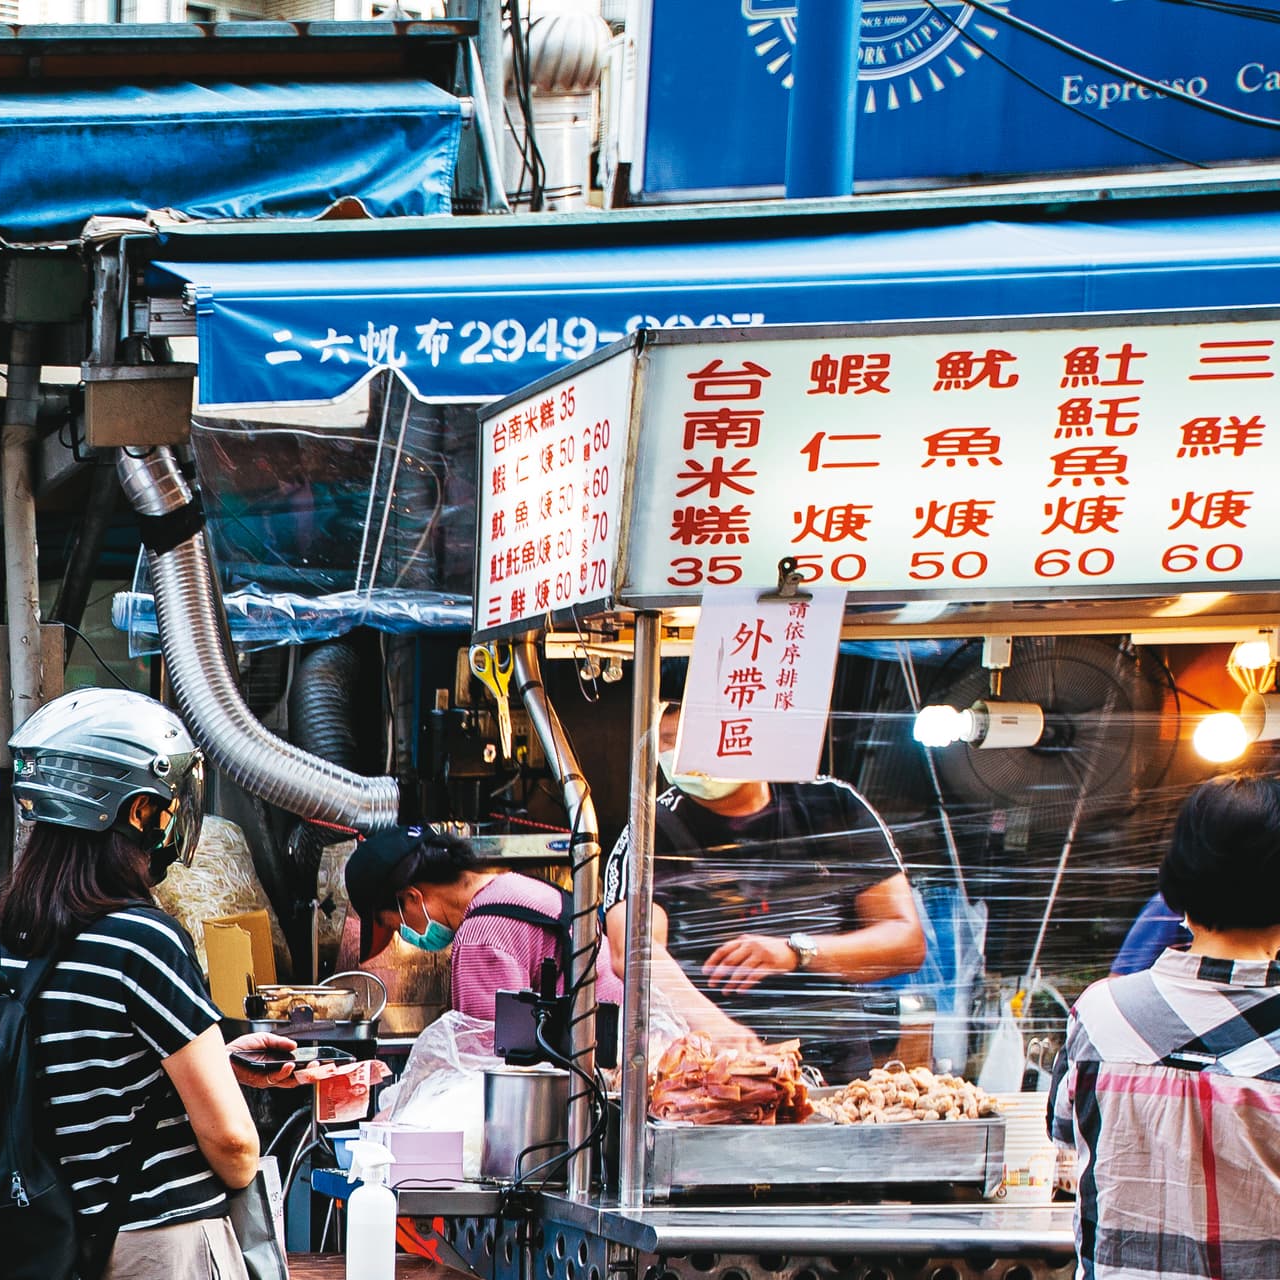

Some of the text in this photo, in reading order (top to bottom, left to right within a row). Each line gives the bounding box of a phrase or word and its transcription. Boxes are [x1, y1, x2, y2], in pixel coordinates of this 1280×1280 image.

[492, 385, 576, 455] 台南米糕 35
[592, 419, 611, 453] 60
[558, 434, 575, 467] 50
[667, 358, 772, 545] 台南米糕
[557, 482, 574, 515] 50
[592, 465, 610, 499] 60
[556, 527, 573, 560] 60
[591, 511, 609, 545] 70
[591, 558, 608, 592] 70
[667, 555, 743, 587] 35
[791, 553, 867, 583] 50
[908, 551, 989, 581] 50
[1033, 547, 1115, 578] 60
[1161, 543, 1244, 574] 60
[555, 570, 572, 602] 60
[774, 601, 811, 712] 請依序排隊
[717, 618, 773, 758] 外帶區
